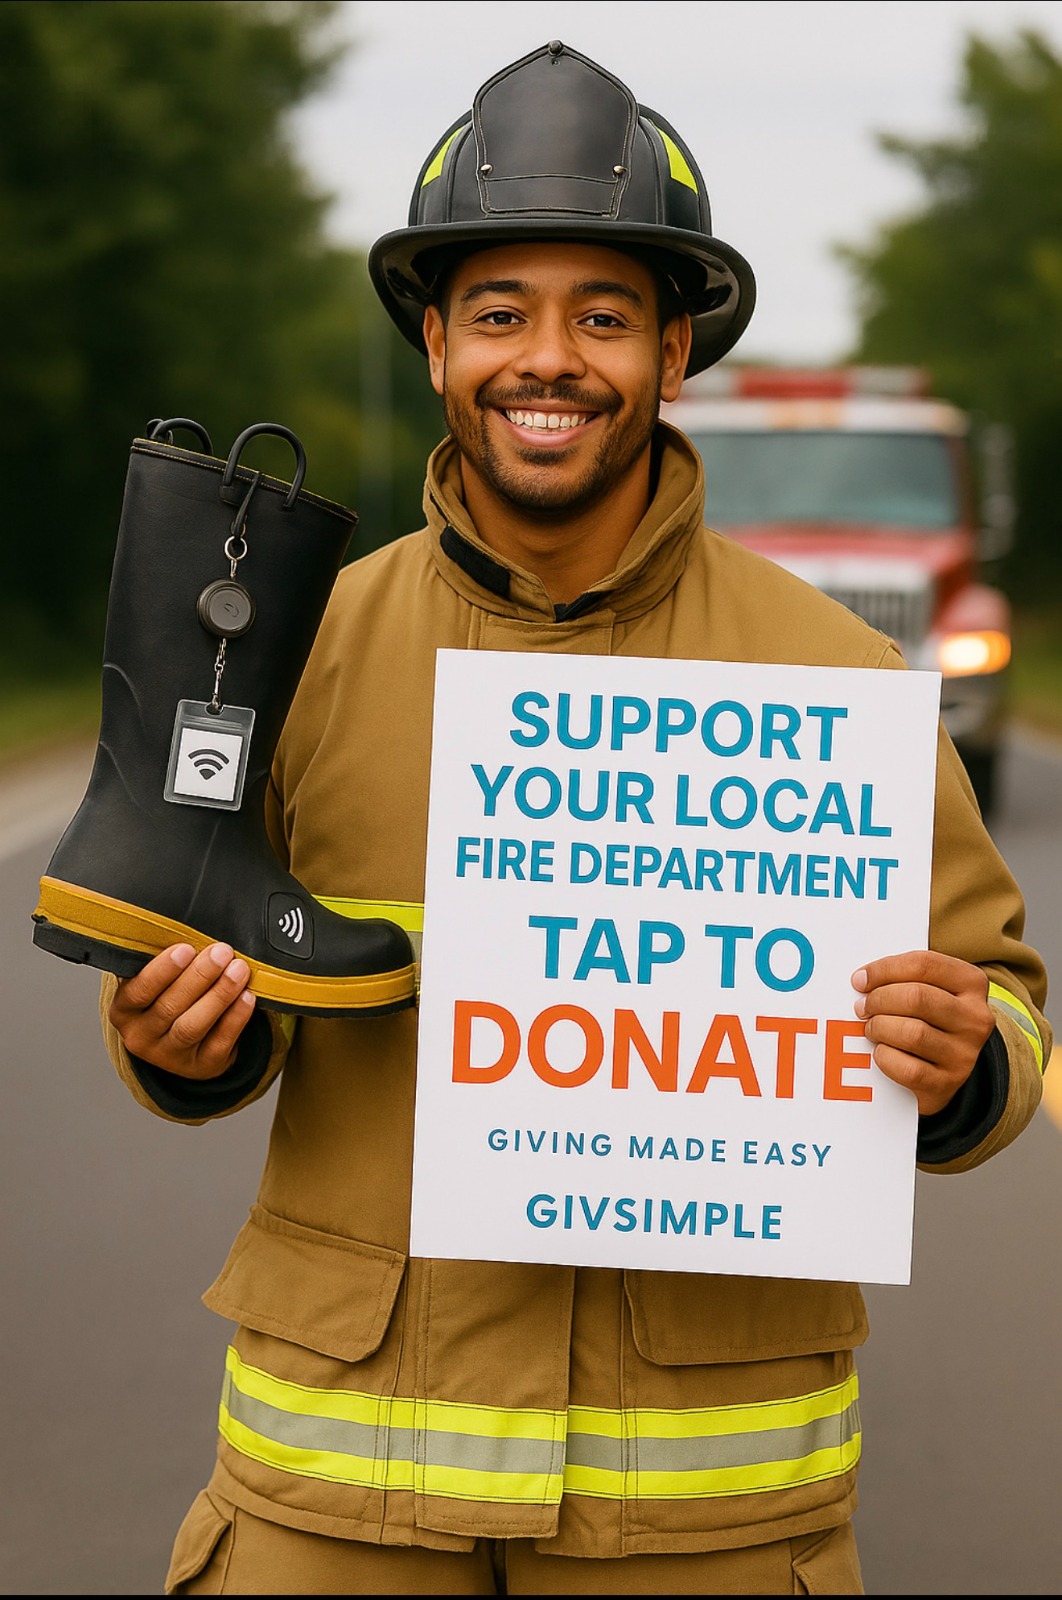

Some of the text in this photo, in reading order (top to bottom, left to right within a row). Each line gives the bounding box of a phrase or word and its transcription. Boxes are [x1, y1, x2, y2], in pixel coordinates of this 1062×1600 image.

[510, 691, 849, 762] SUPPORT
[471, 763, 892, 838] YOUR LOCAL
[456, 836, 899, 901] FIRE DEPARTMENT
[528, 915, 815, 993] TAP TO
[451, 999, 874, 1102] DONATE
[487, 1129, 832, 1168] GIVING MADE EASY
[526, 1193, 783, 1240] GIVSIMPLE
